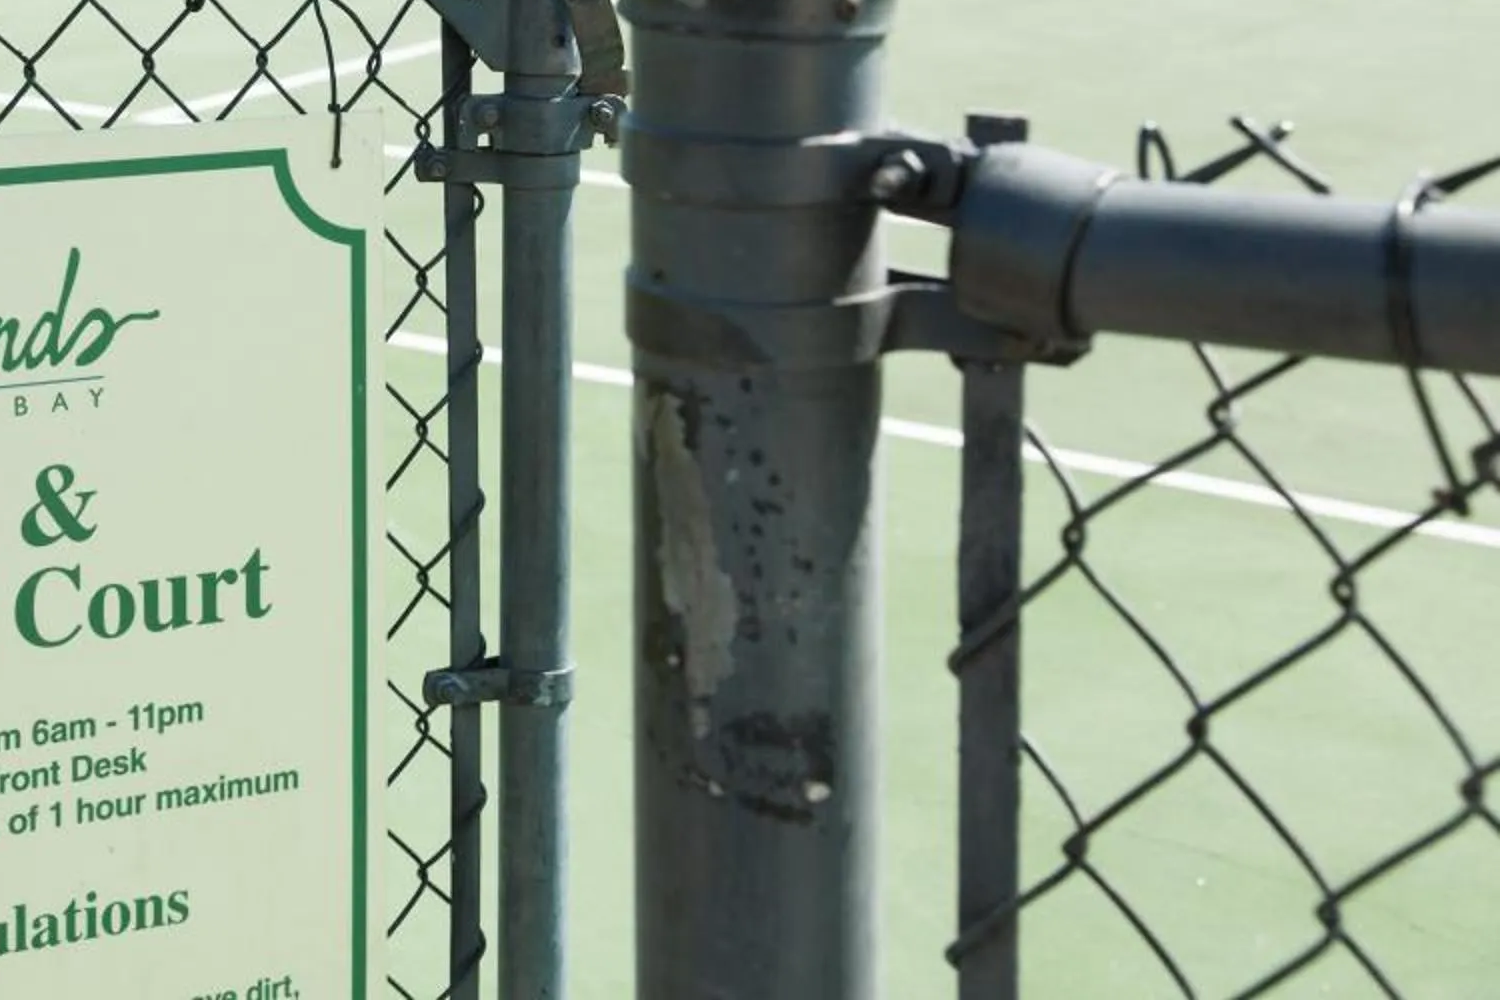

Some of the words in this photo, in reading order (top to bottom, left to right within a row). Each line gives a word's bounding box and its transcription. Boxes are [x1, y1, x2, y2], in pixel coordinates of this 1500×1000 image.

[13, 384, 108, 417] BAY
[19, 462, 98, 548] &
[13, 546, 273, 649] Court
[30, 716, 97, 747] 6am
[126, 700, 204, 735] 11pm
[70, 745, 147, 783] Desk
[6, 803, 39, 835] of
[48, 800, 62, 828] 1
[75, 792, 147, 825] hour
[154, 768, 299, 811] maximum
